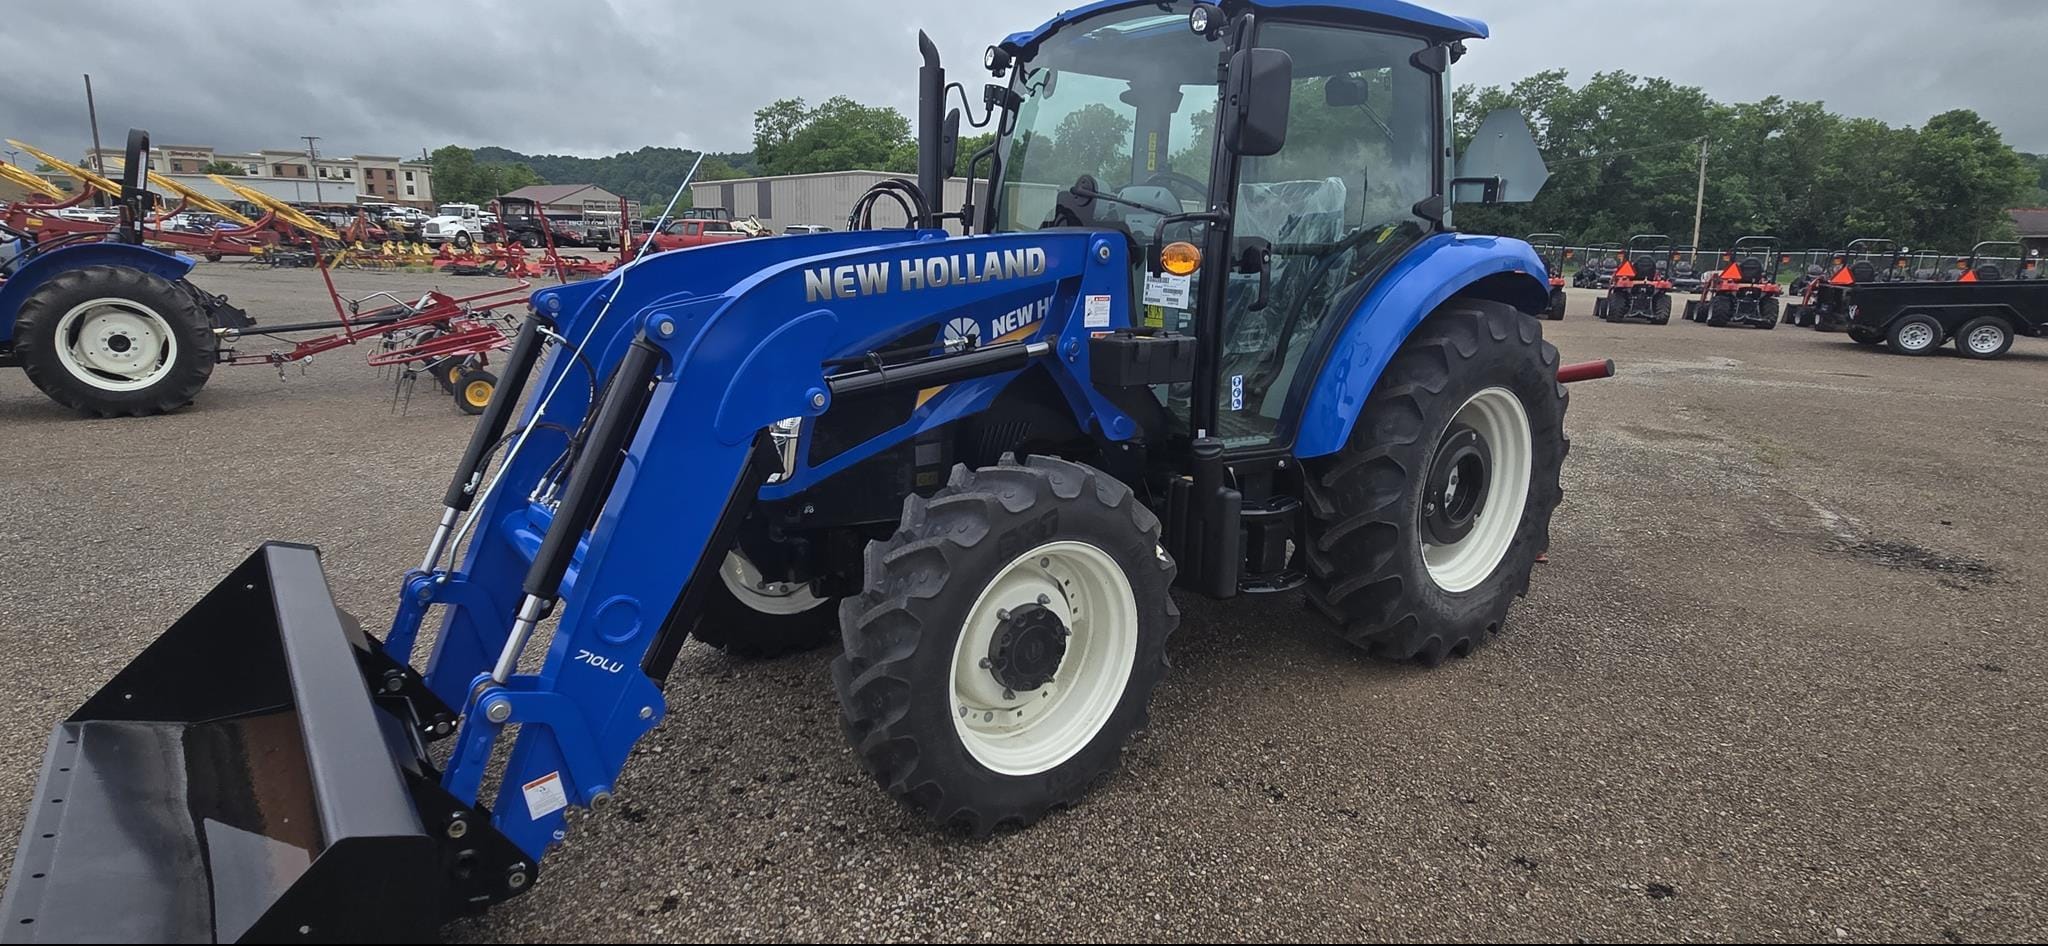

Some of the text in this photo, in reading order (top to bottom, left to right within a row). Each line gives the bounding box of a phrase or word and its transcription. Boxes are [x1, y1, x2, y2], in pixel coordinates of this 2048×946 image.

[804, 247, 1046, 302] NEW HOLLAND
[992, 302, 1034, 339] NEW
[1037, 295, 1054, 319] H
[574, 649, 624, 673] 710LU
